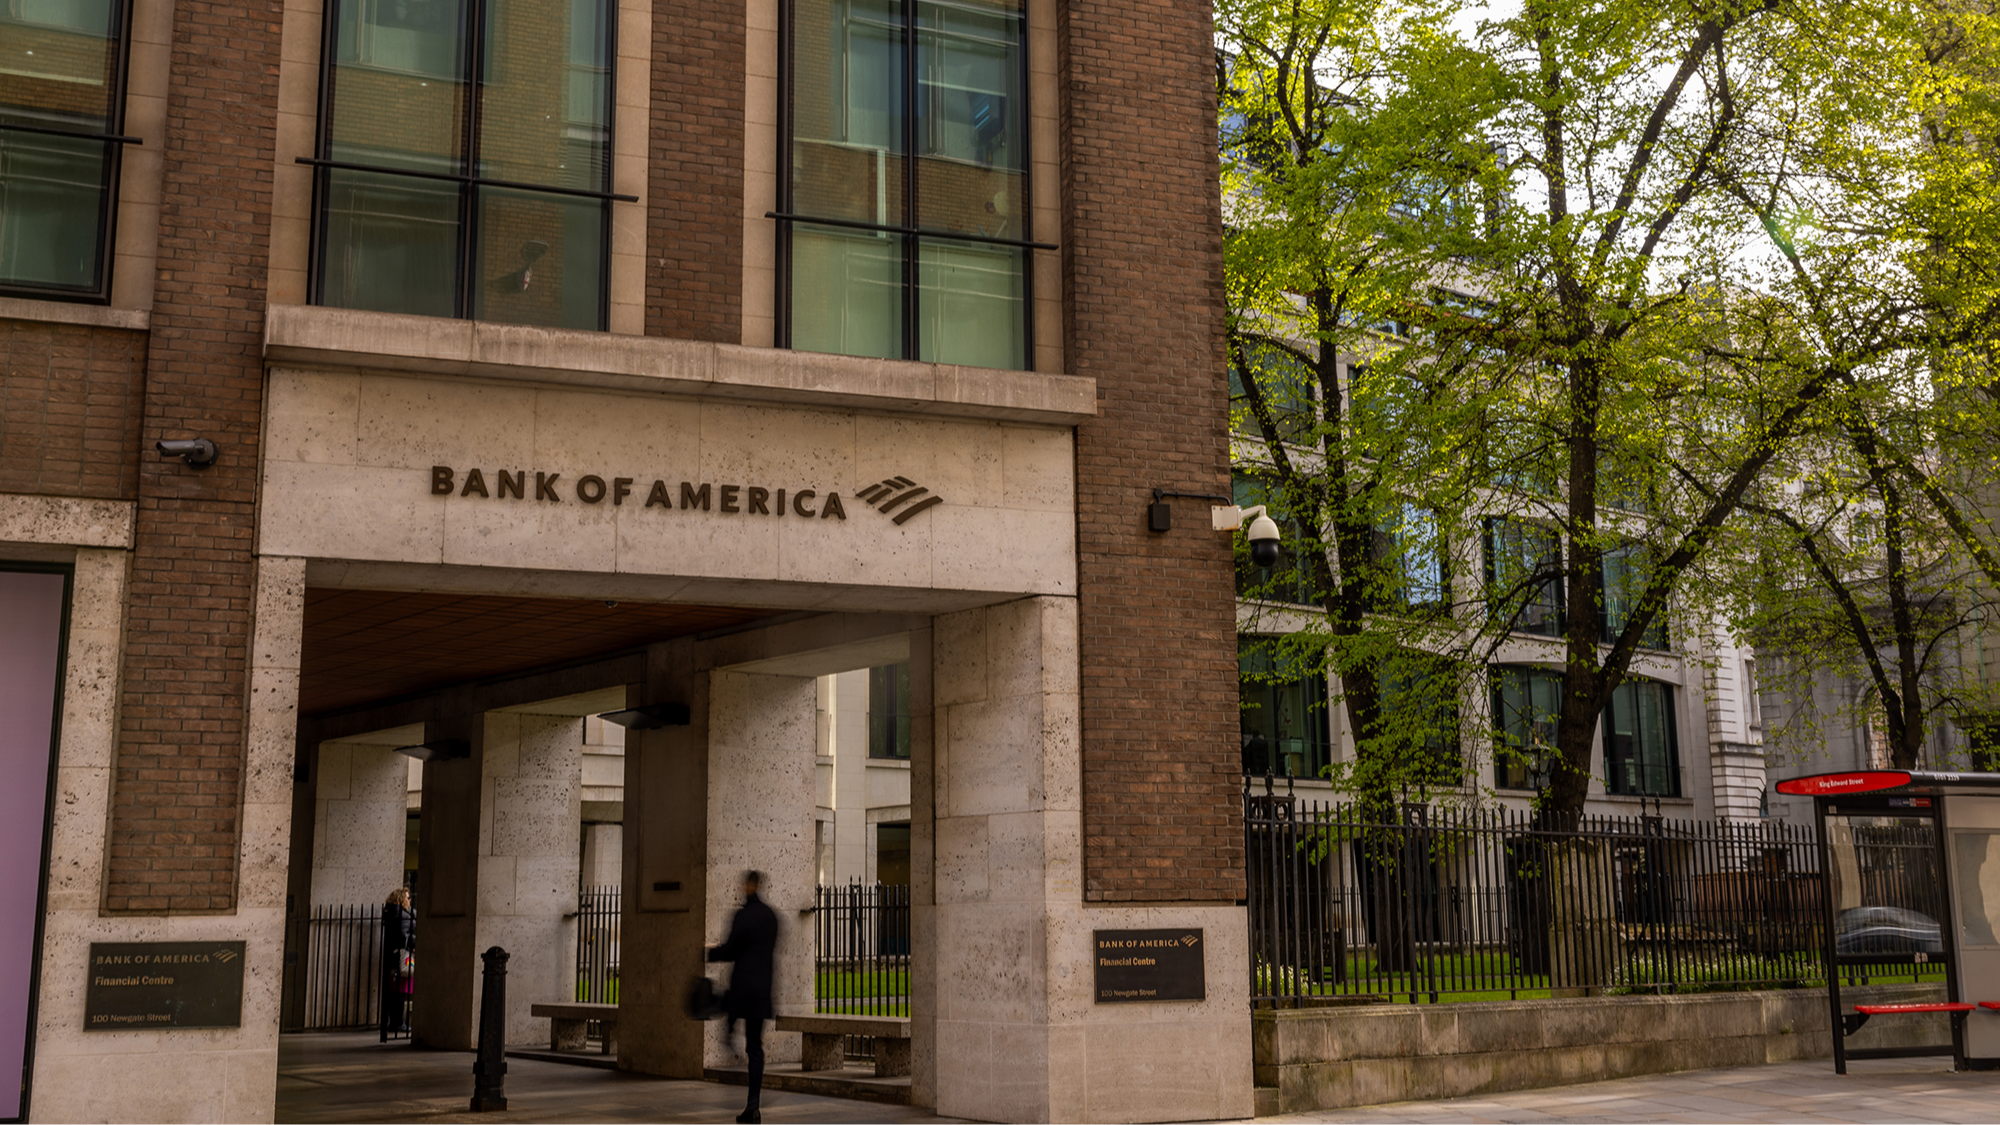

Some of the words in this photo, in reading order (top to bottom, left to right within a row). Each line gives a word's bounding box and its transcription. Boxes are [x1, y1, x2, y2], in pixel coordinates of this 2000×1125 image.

[431, 465, 560, 502] BANK
[576, 474, 633, 506] OF
[645, 478, 847, 520] AMERICA
[1819, 781, 1830, 789] King
[1830, 779, 1848, 787] Edward
[1100, 940, 1124, 949] BANK
[1126, 940, 1138, 948] OF
[1139, 939, 1179, 948] AMERICA
[96, 955, 131, 965] BANK
[134, 955, 151, 964] OF
[153, 954, 210, 964] AMERICA
[1100, 957, 1132, 967] Financial
[1133, 957, 1156, 966] Centre
[95, 976, 140, 987] Financial
[142, 975, 174, 986] Centre
[1114, 990, 1139, 998] Newgate
[92, 1014, 109, 1024] 100
[110, 1014, 145, 1024] Newgate
[146, 1013, 172, 1022] Street
